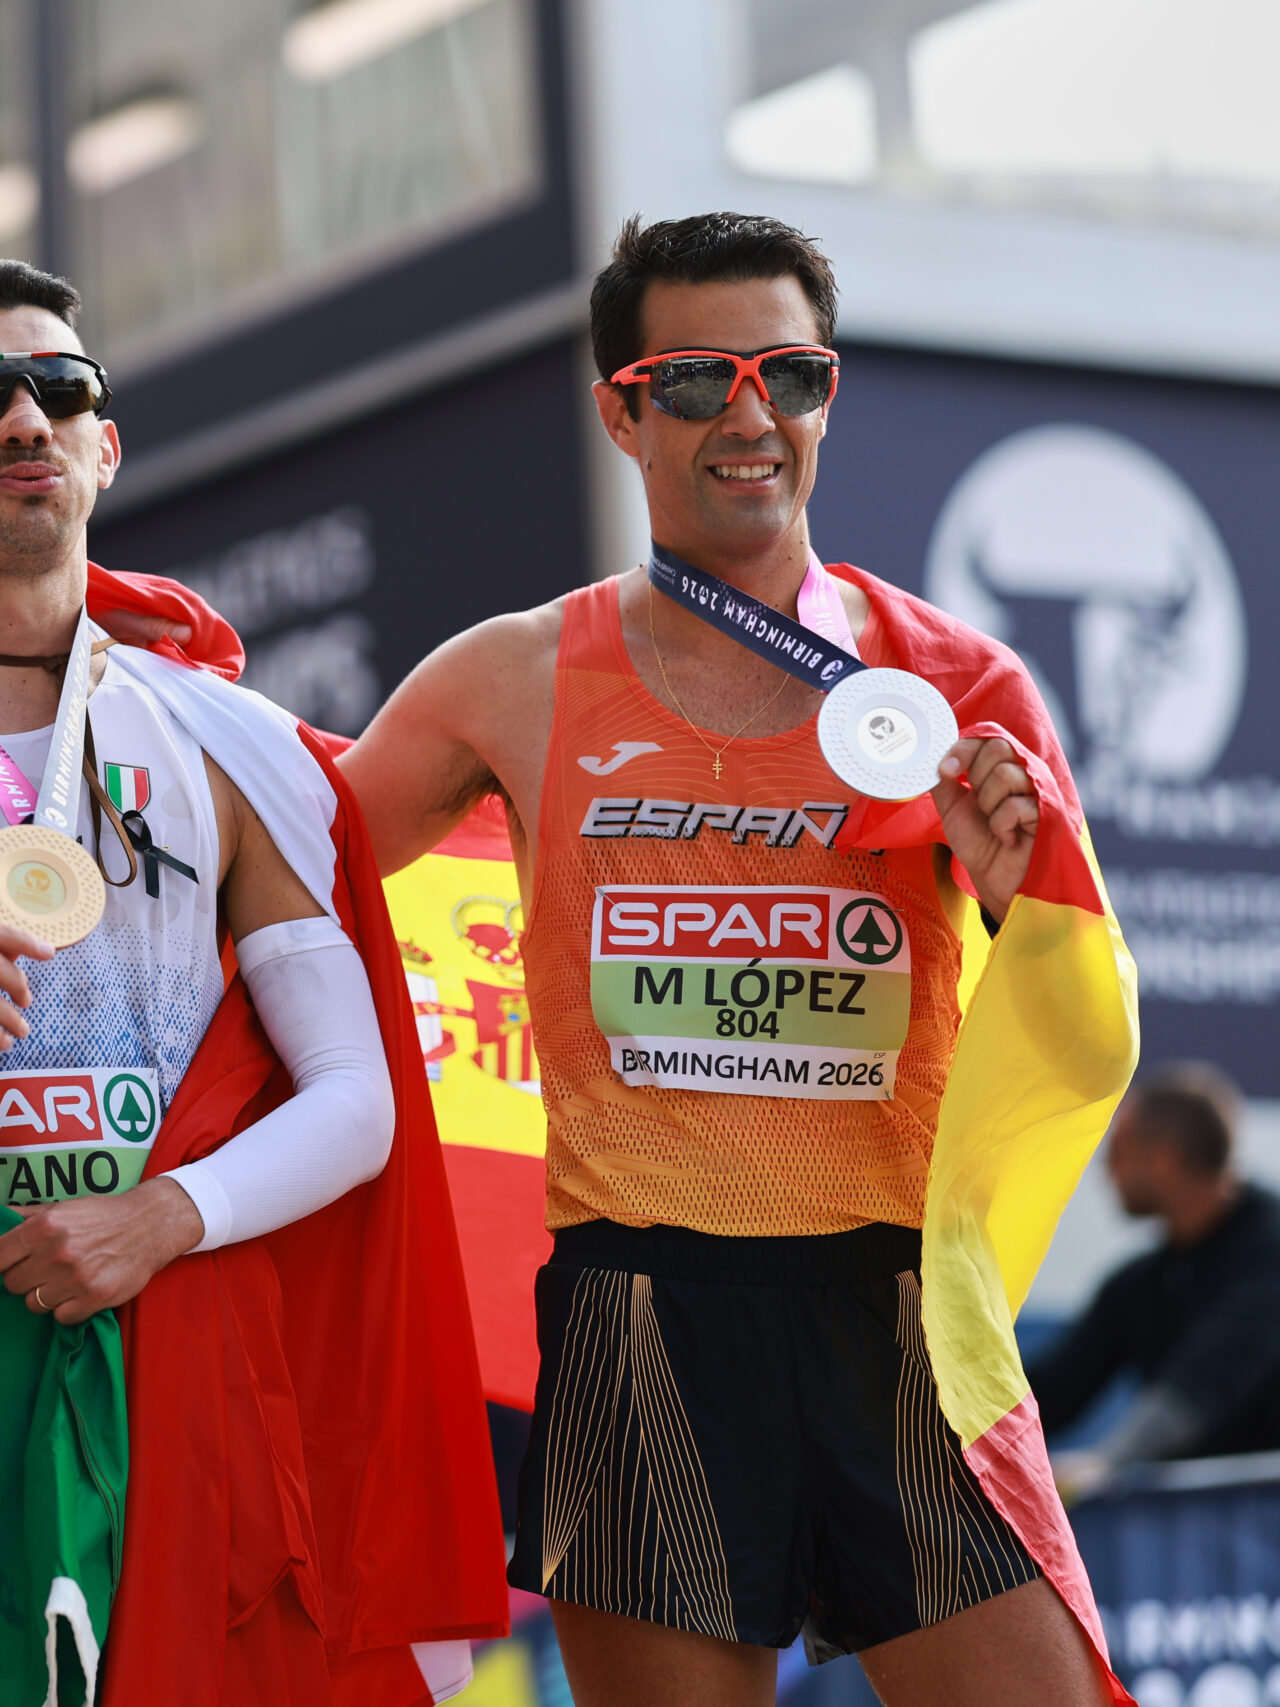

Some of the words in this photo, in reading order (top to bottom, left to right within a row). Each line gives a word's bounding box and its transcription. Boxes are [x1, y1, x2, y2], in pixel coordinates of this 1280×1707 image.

[723, 600, 823, 669] BIRMINGHAM
[579, 796, 852, 851] ESPAÑ
[607, 901, 823, 949] SPAR
[633, 966, 684, 1006] M
[704, 958, 866, 1016] LÓPEZ
[715, 1008, 780, 1039] 804
[817, 1062, 884, 1087] 2026
